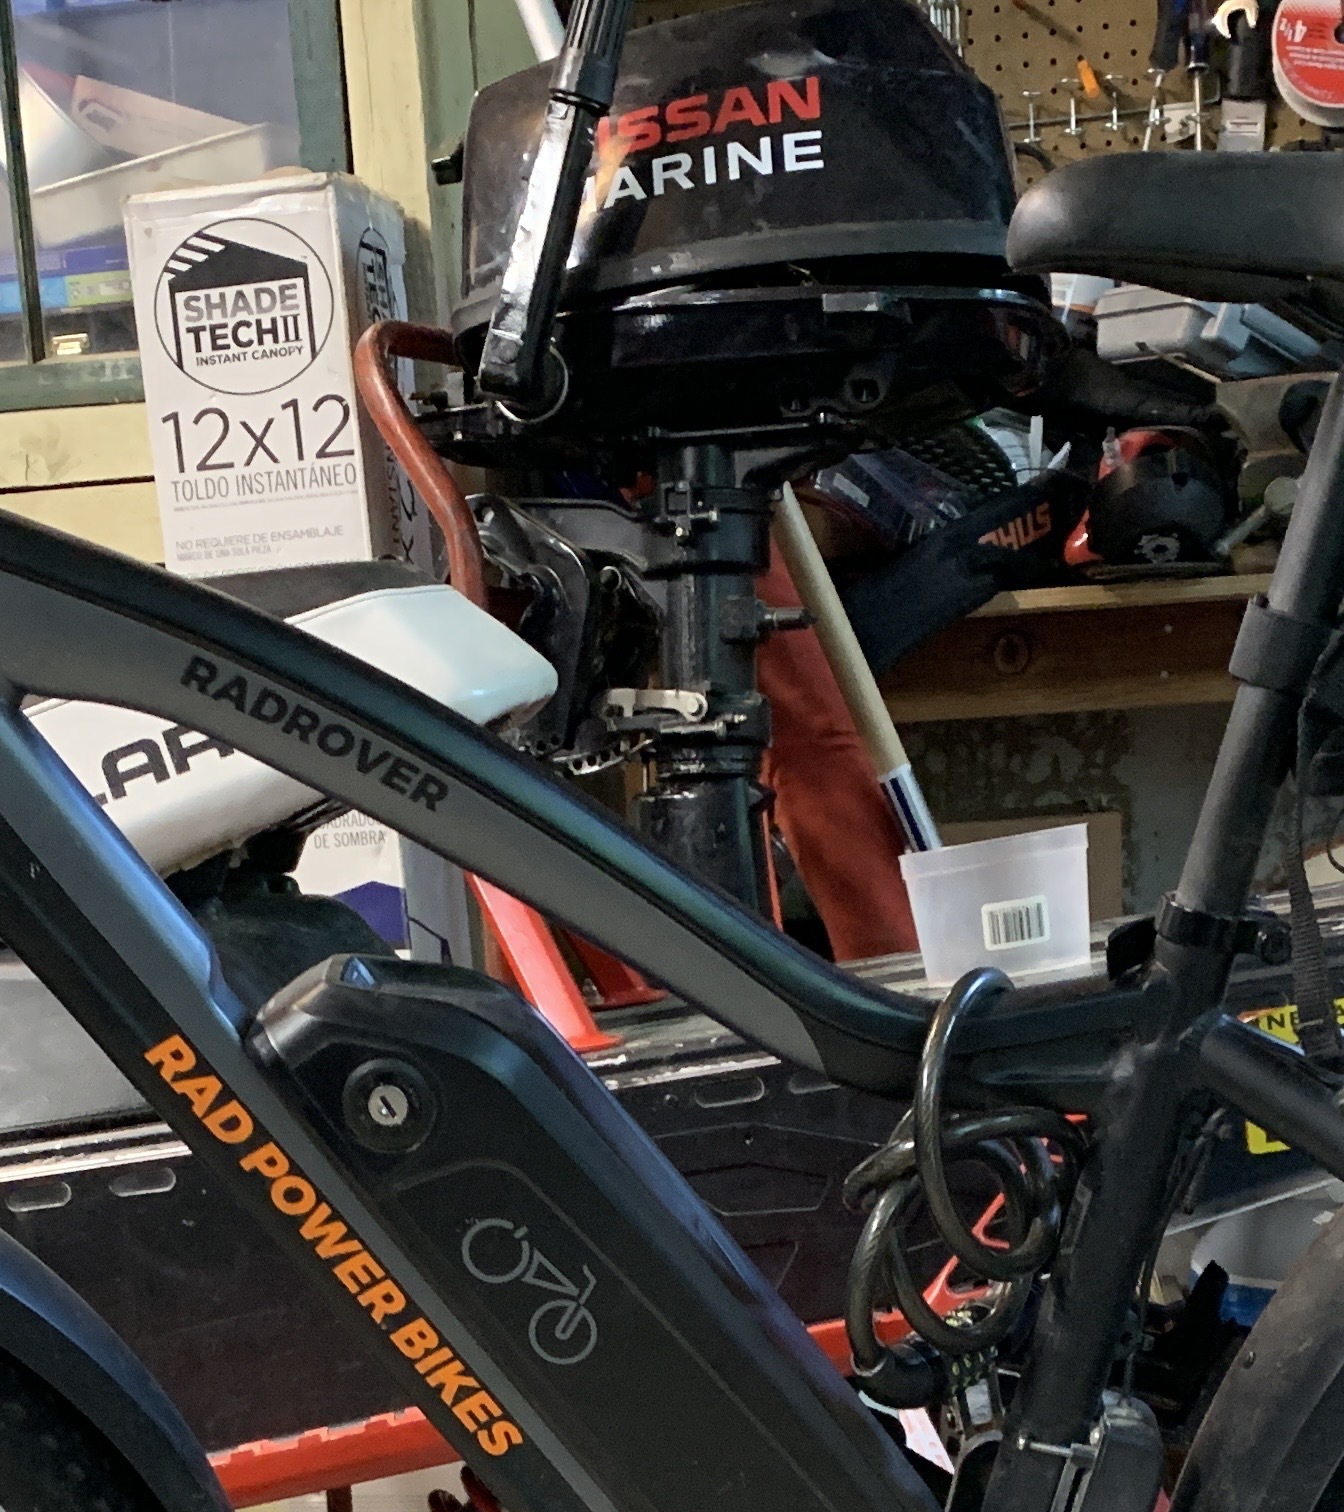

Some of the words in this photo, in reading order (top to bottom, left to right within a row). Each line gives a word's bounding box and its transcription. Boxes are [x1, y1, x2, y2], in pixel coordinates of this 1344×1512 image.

[596, 76, 822, 162] ISSAN
[183, 283, 300, 323] SHADE
[196, 351, 248, 367] INSTANT
[251, 345, 304, 361] CANOPY
[161, 394, 355, 473] 12x12
[171, 476, 230, 502] TOLDO
[236, 462, 357, 497] INSTANTÁNEO
[176, 540, 193, 551] NO
[195, 533, 250, 549] REQUIERE
[253, 533, 269, 544] DE
[180, 655, 449, 812] RADROVER
[314, 833, 330, 849] DE
[334, 830, 386, 848] SOMBRA
[144, 1034, 254, 1145] RAD
[239, 1141, 407, 1325] POWER
[390, 1317, 524, 1457] BIKES
